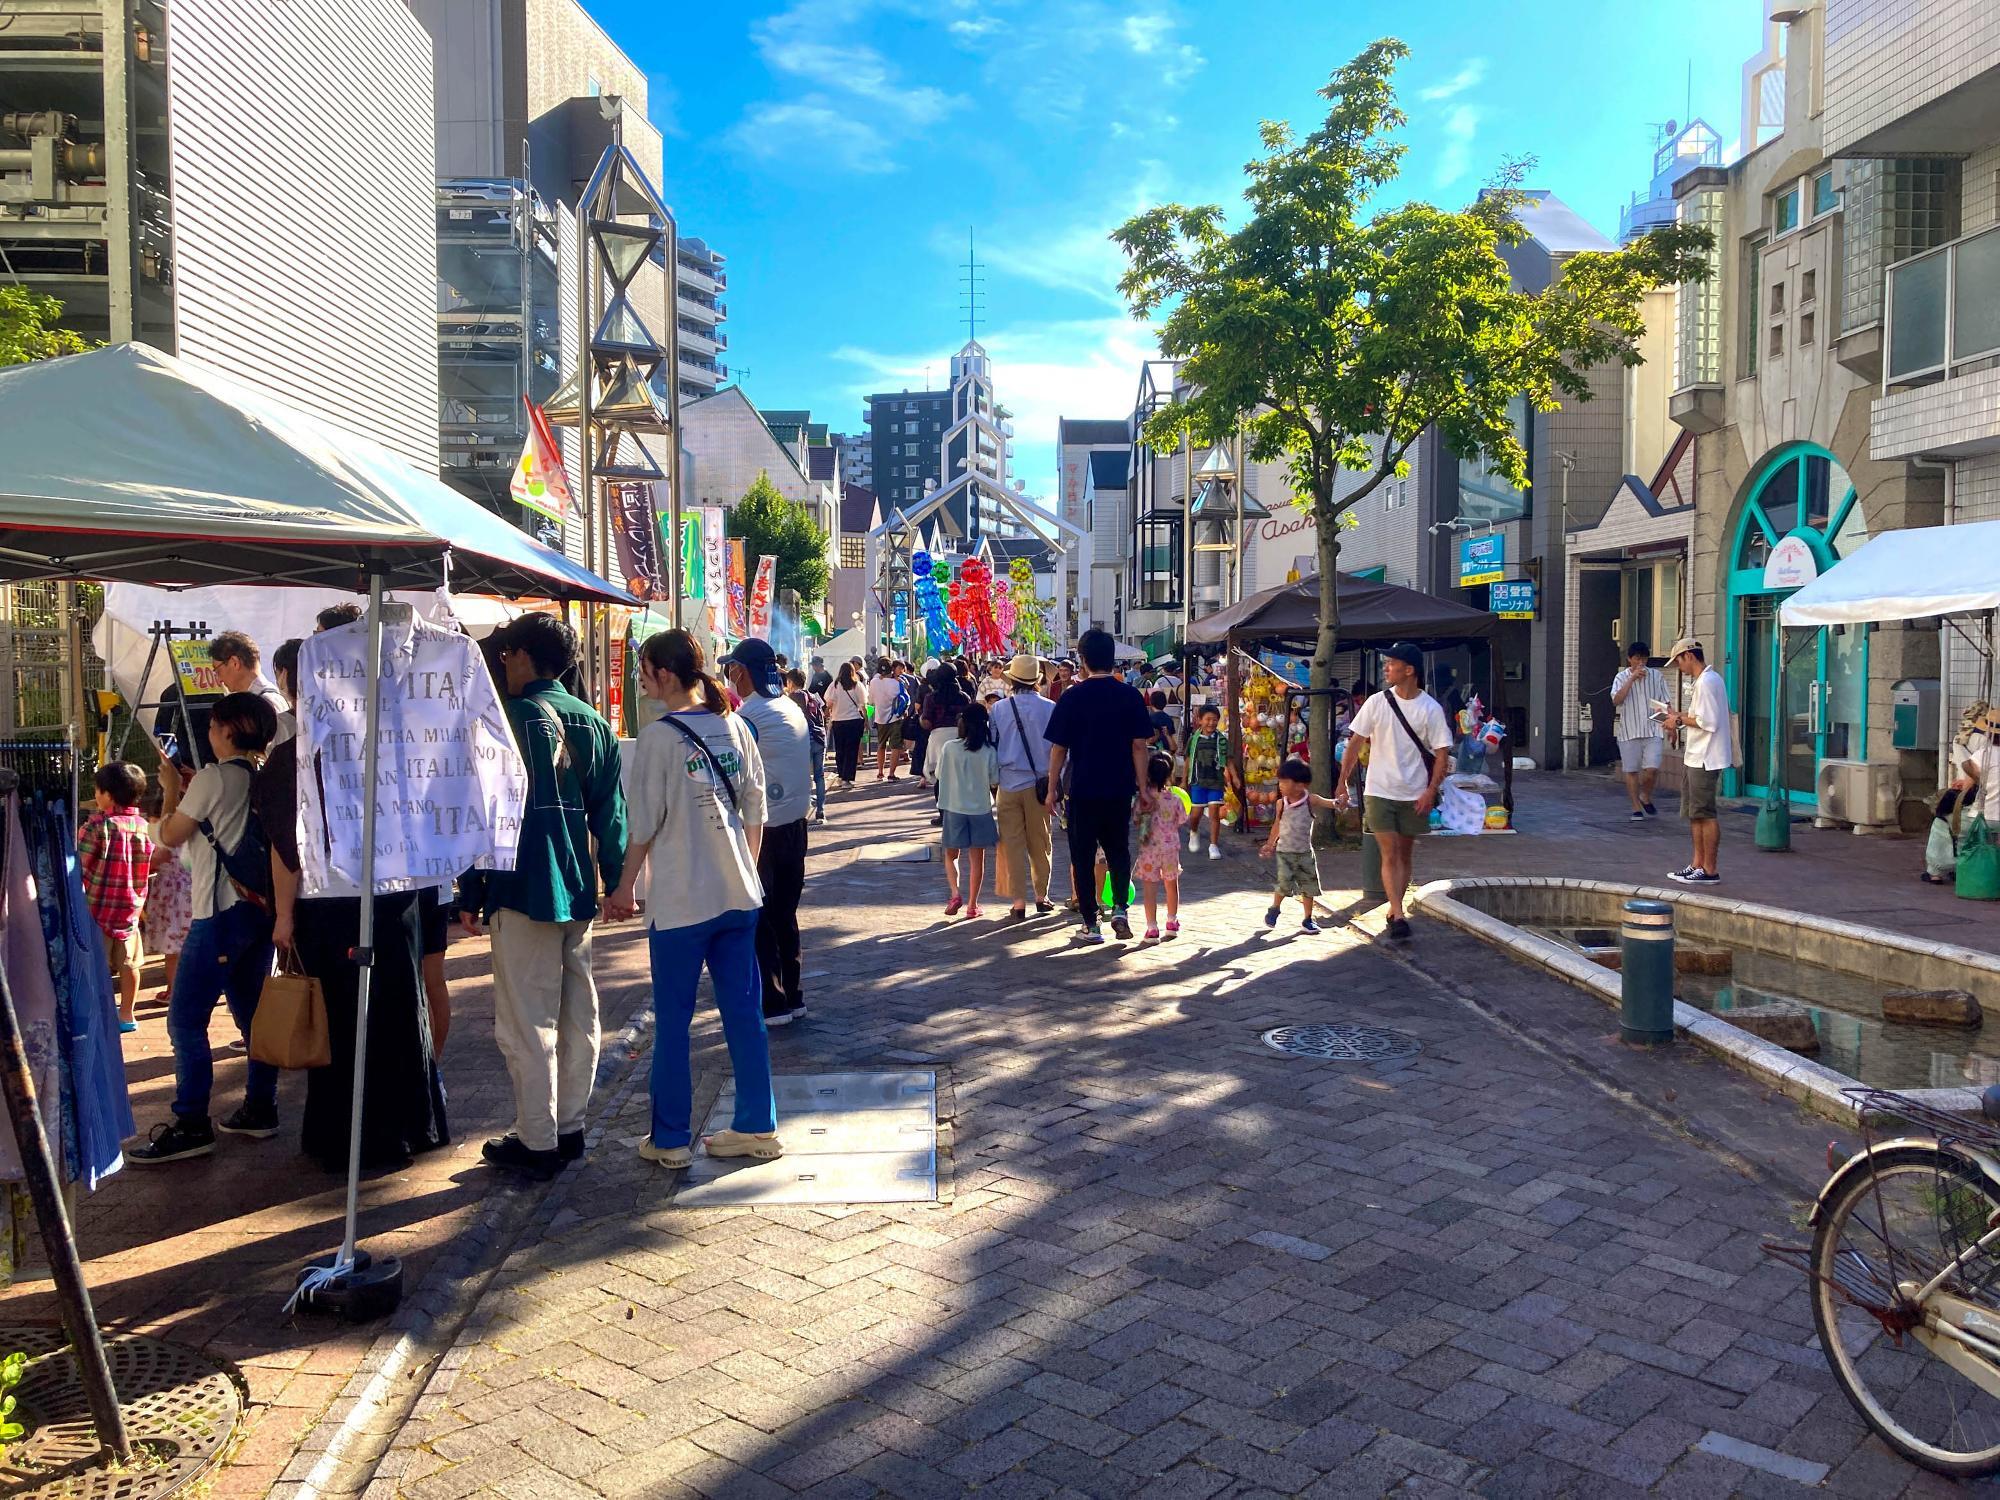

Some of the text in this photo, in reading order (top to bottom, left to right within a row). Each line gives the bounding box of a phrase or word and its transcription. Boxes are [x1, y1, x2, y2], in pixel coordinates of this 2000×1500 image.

[1262, 514, 1317, 541] Asah
[1492, 600, 1532, 610] パーソナル
[407, 671, 456, 699] ITA
[407, 757, 478, 778] ITALIA
